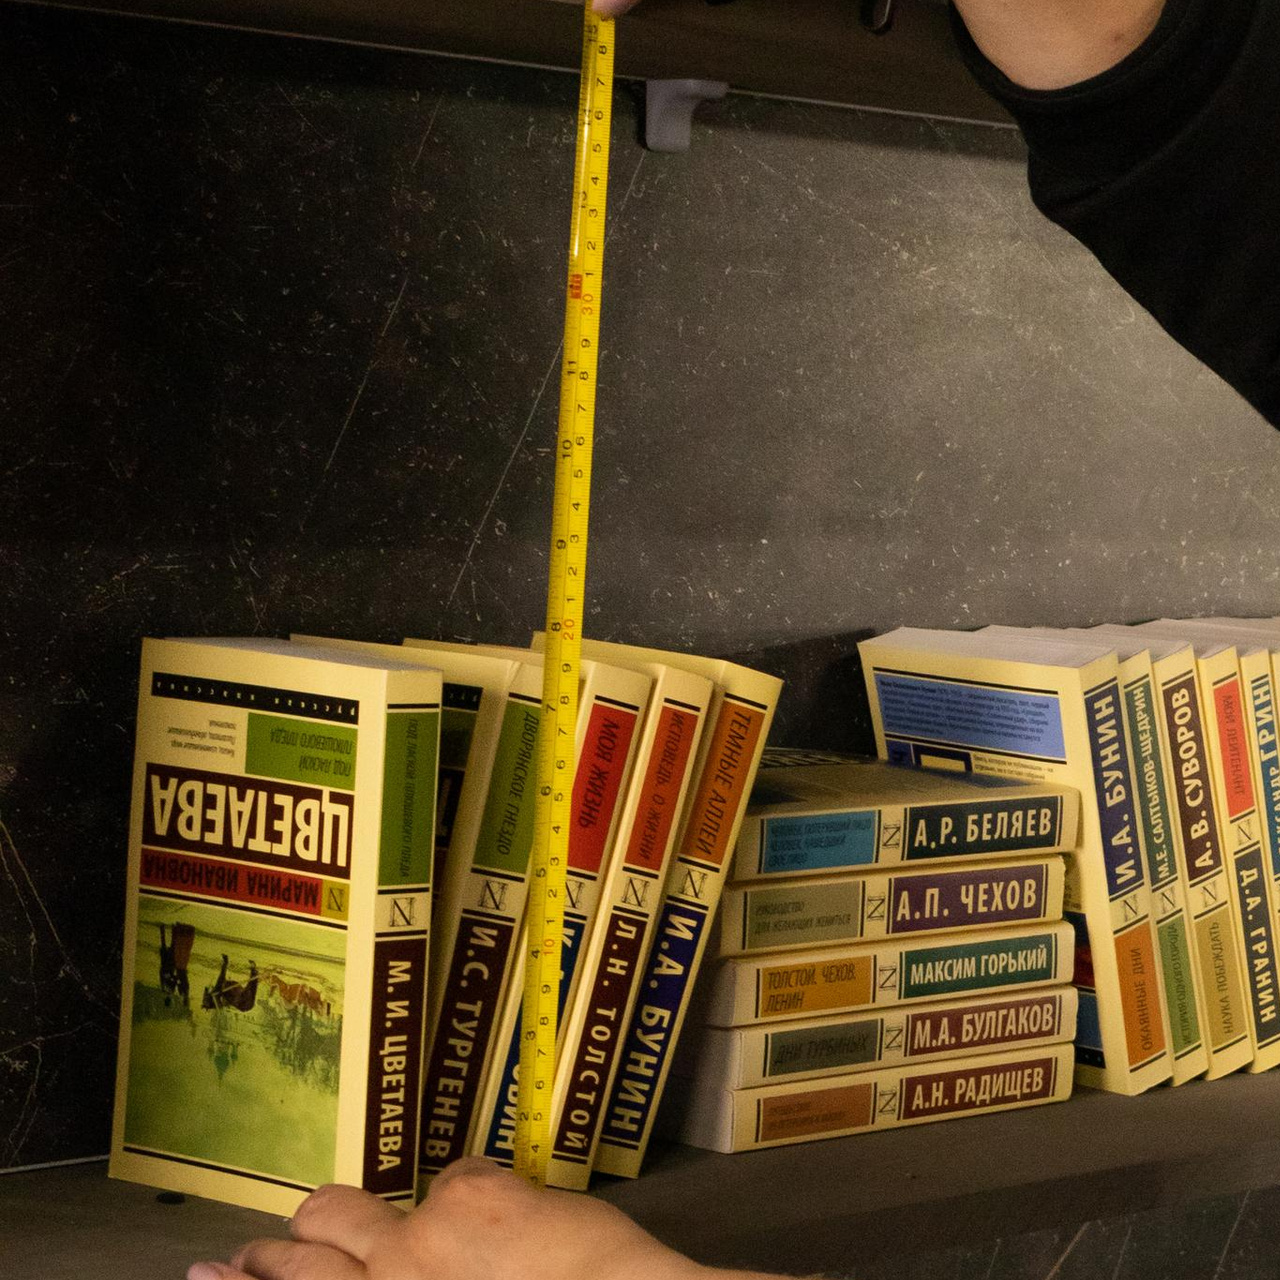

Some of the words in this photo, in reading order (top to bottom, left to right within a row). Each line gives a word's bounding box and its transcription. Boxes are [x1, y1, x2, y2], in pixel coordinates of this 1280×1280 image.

[598, 45, 608, 55] 8
[596, 78, 605, 86] 7
[594, 110, 604, 120] 6
[592, 143, 602, 153] 5
[591, 176, 600, 185] 4
[589, 208, 598, 218] 3
[587, 241, 596, 250] 2
[582, 293, 593, 315] 30
[581, 338, 591, 348] 9
[567, 360, 577, 376] 11
[579, 371, 589, 381] 8
[577, 404, 586, 413] 7
[576, 436, 585, 446] 6
[562, 439, 572, 459] 10
[574, 469, 583, 478] 5
[572, 502, 581, 511] 4
[556, 539, 567, 550] 9
[570, 534, 579, 544] 3
[568, 566, 577, 576] 2
[551, 621, 562, 632] 8
[563, 619, 575, 640] 20
[562, 663, 571, 673] 9
[560, 695, 570, 705] 8
[546, 704, 556, 714] 7
[1252, 684, 1278, 762] ГРИН
[558, 728, 567, 736] 7
[597, 717, 621, 763] МОЯ
[715, 711, 751, 790] ТЕМНЫЕ
[1093, 694, 1127, 808] БУНИН
[1171, 687, 1204, 808] СУВОРОВ
[508, 711, 539, 799] ДВОРЯНСКОЕ
[556, 759, 565, 769] 6
[1132, 687, 1166, 845] САЛТЫКОВ-ЩЕДРИН
[541, 785, 551, 796] 6
[554, 792, 563, 802] 5
[579, 764, 611, 829] ЖИЗНЬ
[653, 793, 665, 805] О
[151, 774, 349, 868] ЦВЕТАЕВА
[696, 790, 727, 855] АЛЛЕИ
[499, 803, 520, 856] ГНЕЗДО
[552, 825, 561, 834] 4
[913, 816, 958, 851] А.Р.
[966, 806, 1052, 843] БЕЛЯЕВ
[640, 809, 665, 860] ЖИЗНИ
[550, 856, 559, 866] 3
[144, 854, 238, 893] ИВАНОВНА
[536, 867, 546, 878] 5
[247, 870, 318, 907] МАРИНА
[548, 888, 558, 898] 2
[896, 888, 950, 922] А.П.
[960, 877, 1038, 912] ЧЕХОВ
[542, 938, 555, 956] 10
[531, 949, 540, 959] 4
[1209, 922, 1228, 993] ПОБЕЖДАТЬ
[909, 953, 977, 987] МАКСИМ
[980, 943, 1047, 975] ГОРЬКИЙ
[1130, 947, 1144, 976] ДНИ
[1250, 927, 1277, 1024] ГРАНИН
[541, 984, 551, 994] 9
[765, 993, 803, 1013] ЛЕНИН
[540, 1016, 549, 1026] 8
[1134, 980, 1153, 1052] ОКАЯННЫЕ
[1218, 999, 1233, 1035] НАУКА
[914, 1014, 957, 1049] М.А.
[961, 1002, 1054, 1041] БУЛГАКОВ
[525, 1030, 536, 1040] 3
[537, 1048, 546, 1057] 7
[610, 1004, 672, 1133] БУНИН
[424, 1000, 483, 1158] ТУРГЕНЕВ
[563, 1007, 617, 1150] ТОЛСТОЙ
[535, 1080, 544, 1090] 6
[911, 1079, 950, 1110] А.Н.
[954, 1066, 1044, 1105] РАДИЩЕВ
[377, 1034, 408, 1172] ЦВЕТАЕВА
[520, 1111, 529, 1121] 2
[533, 1112, 542, 1121] 5
[531, 1144, 540, 1153] 4
